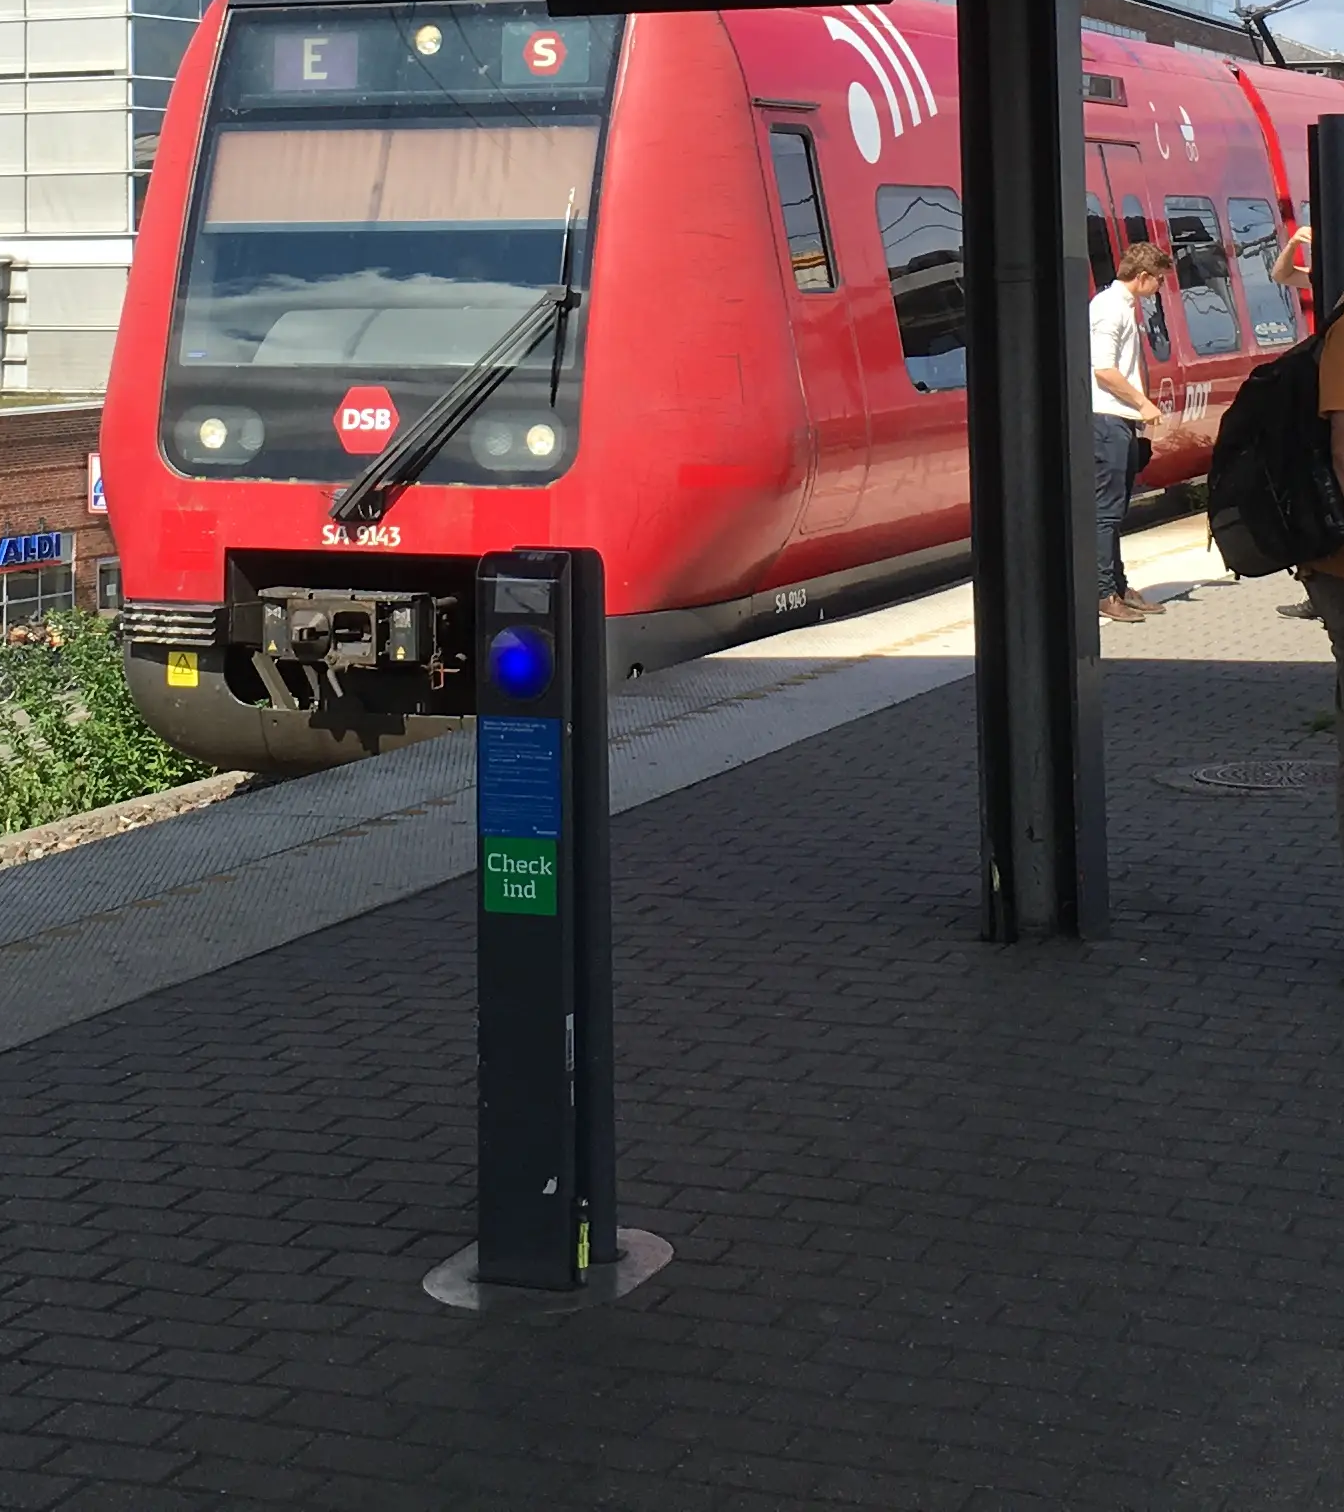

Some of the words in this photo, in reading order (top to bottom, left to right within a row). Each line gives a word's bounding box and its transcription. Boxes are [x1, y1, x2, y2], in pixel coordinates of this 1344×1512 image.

[303, 38, 328, 80] E
[531, 37, 557, 67] S
[342, 408, 391, 430] DSB
[321, 524, 350, 545] SA
[356, 525, 401, 547] 9143
[487, 852, 552, 886] Check
[503, 878, 537, 900] ind
